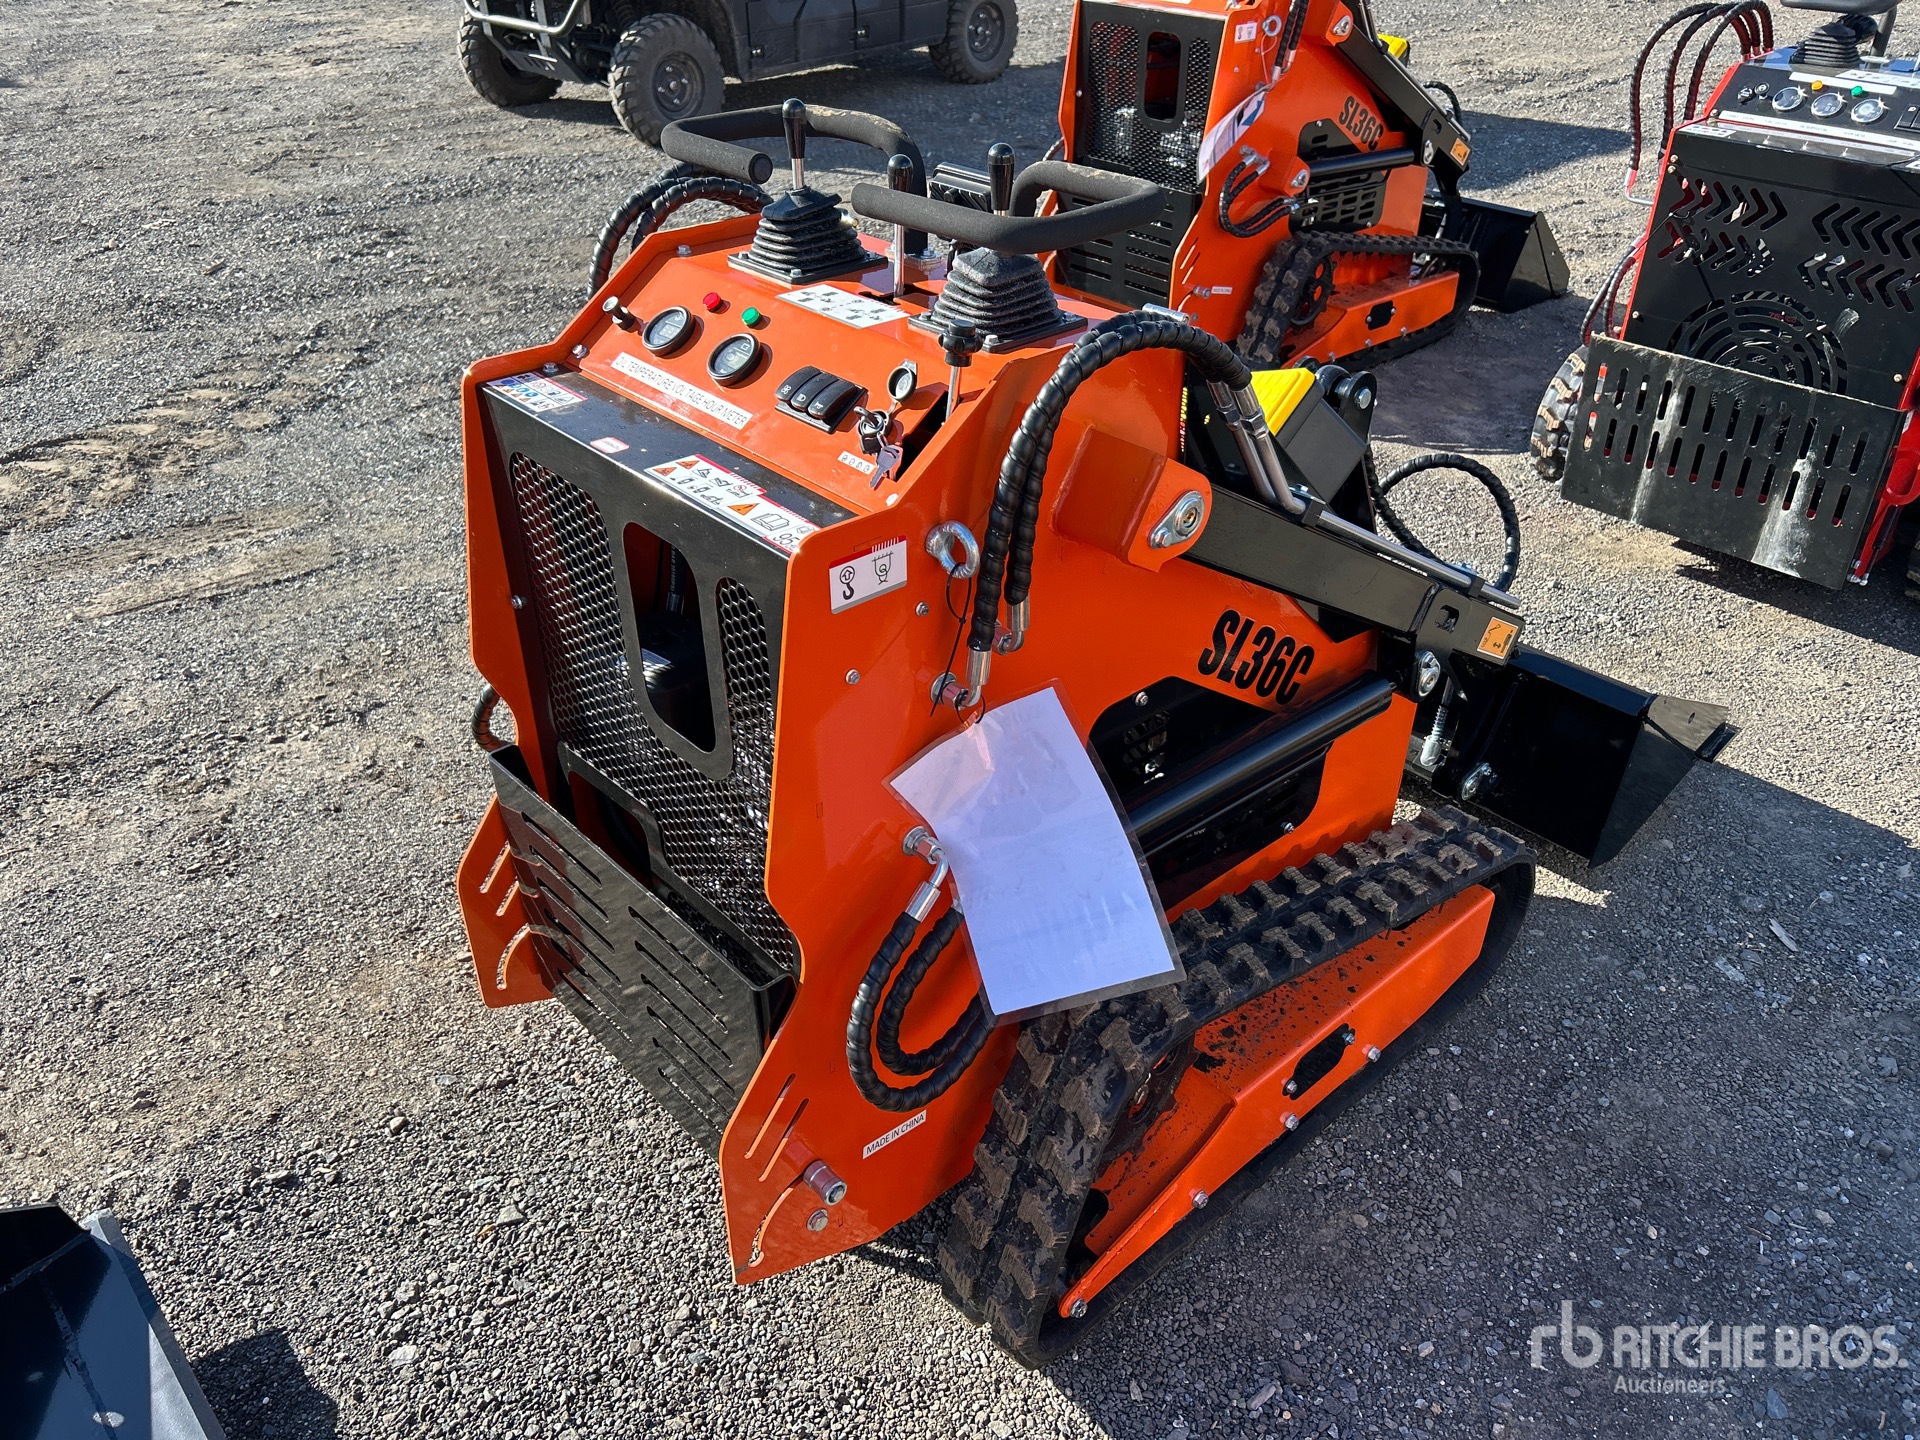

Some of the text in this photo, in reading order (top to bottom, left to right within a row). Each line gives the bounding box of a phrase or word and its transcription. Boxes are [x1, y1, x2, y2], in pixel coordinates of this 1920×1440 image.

[1338, 96, 1384, 151] SL36C
[615, 356, 626, 369] OIL
[629, 360, 674, 390] TEMPERATURE
[703, 395, 726, 414] HOUR
[720, 406, 748, 427] METER
[1198, 610, 1314, 704] SL36C
[866, 1113, 924, 1154] MADE IN CHINA
